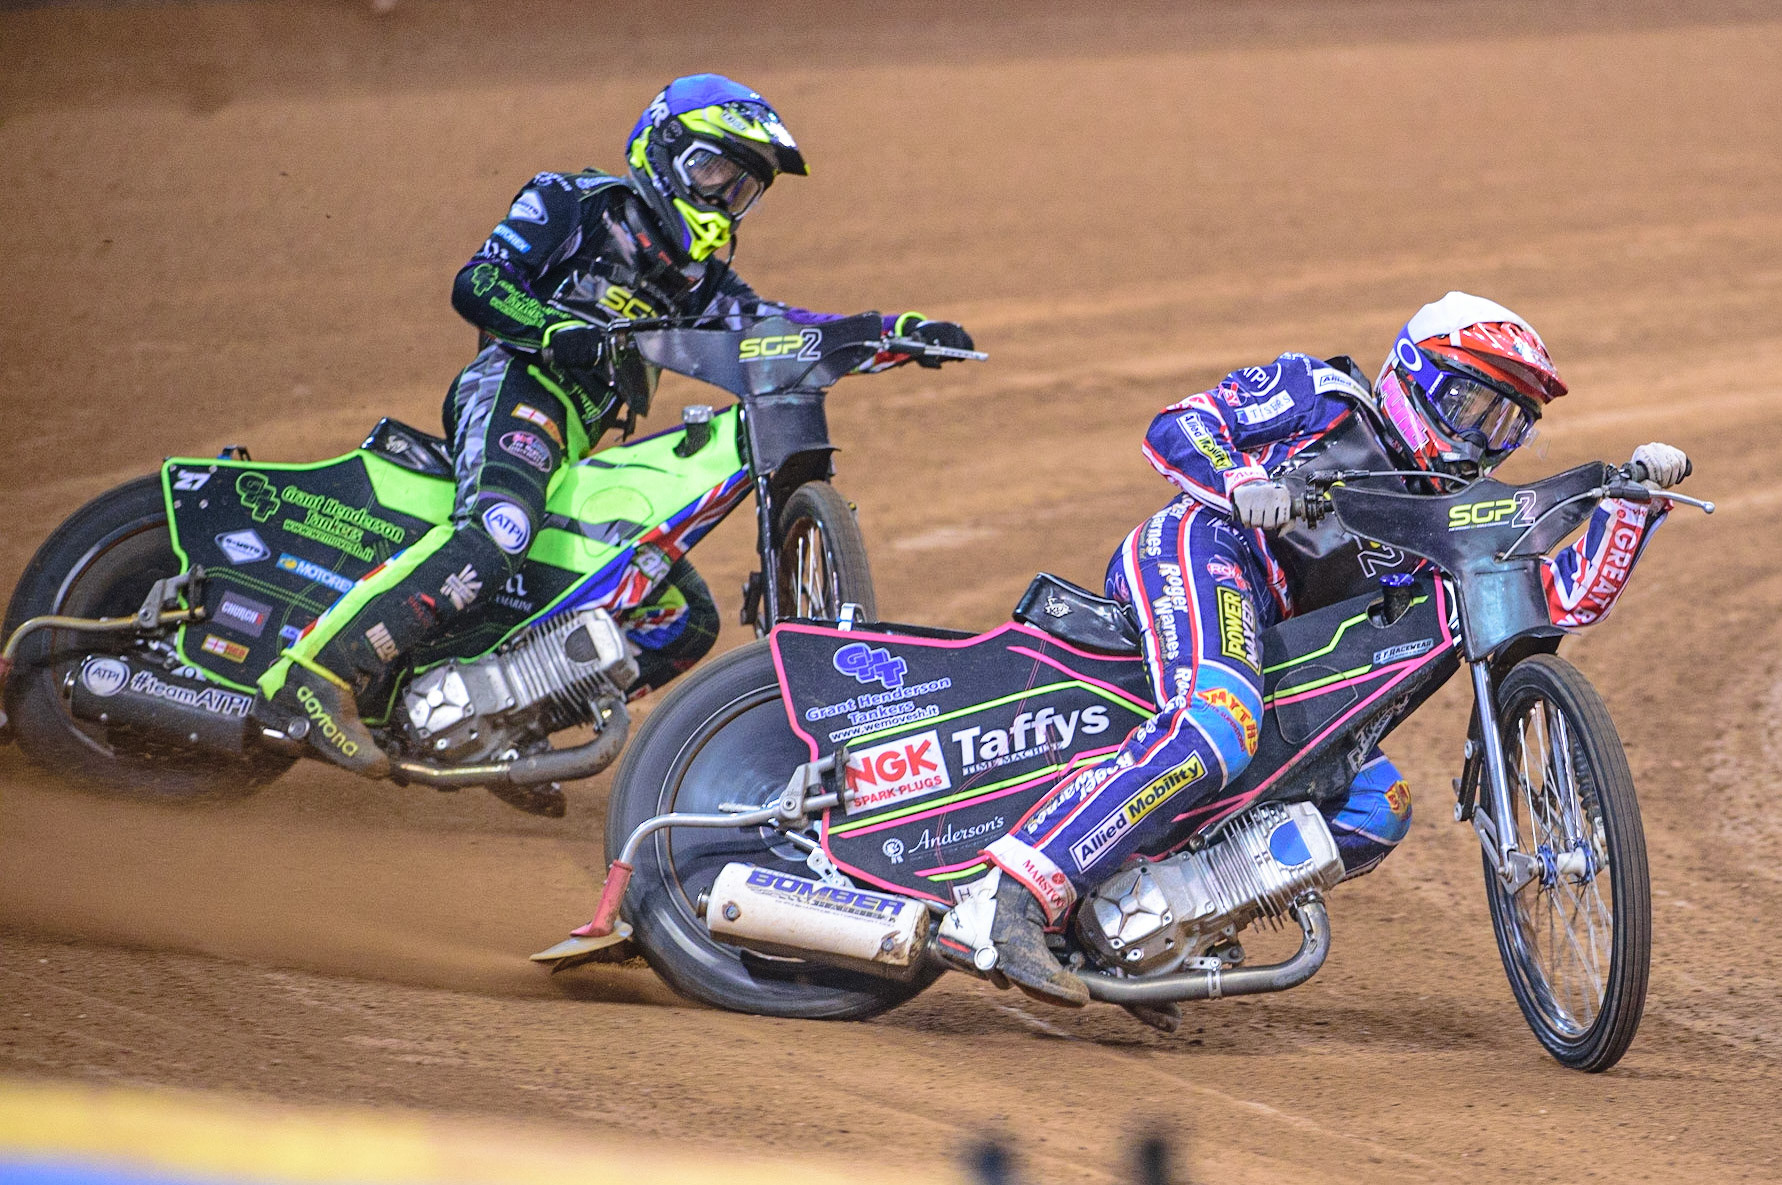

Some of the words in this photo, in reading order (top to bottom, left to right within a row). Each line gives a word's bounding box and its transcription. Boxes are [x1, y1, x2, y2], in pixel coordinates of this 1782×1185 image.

[739, 328, 822, 362] SGP2
[173, 469, 211, 491] 27
[281, 485, 325, 510] Grant
[324, 498, 405, 544] Henderson
[304, 510, 364, 542] Tankers
[491, 513, 523, 543] ATPI
[1449, 490, 1536, 528] SGP2
[1158, 561, 1188, 613] Roger
[1588, 528, 1637, 609] GREAT
[1153, 596, 1180, 661] Warnes
[1224, 590, 1247, 658] POWER
[91, 666, 120, 682] ATPI
[130, 670, 252, 718] #teamATPI
[296, 685, 359, 758] daytona
[806, 698, 857, 721] Grant
[858, 677, 952, 709] Henderson
[848, 700, 915, 725] Tankers
[829, 704, 939, 743] www.wemovesh.it
[952, 705, 1110, 768] Taffys
[844, 739, 938, 793] NGK
[853, 787, 897, 808] SPARK
[899, 775, 943, 795] PLUGS
[1081, 814, 1127, 861] Allied
[1128, 761, 1199, 819] Mobility
[908, 816, 1005, 854] Anderson's
[746, 869, 906, 916] BOMBER
